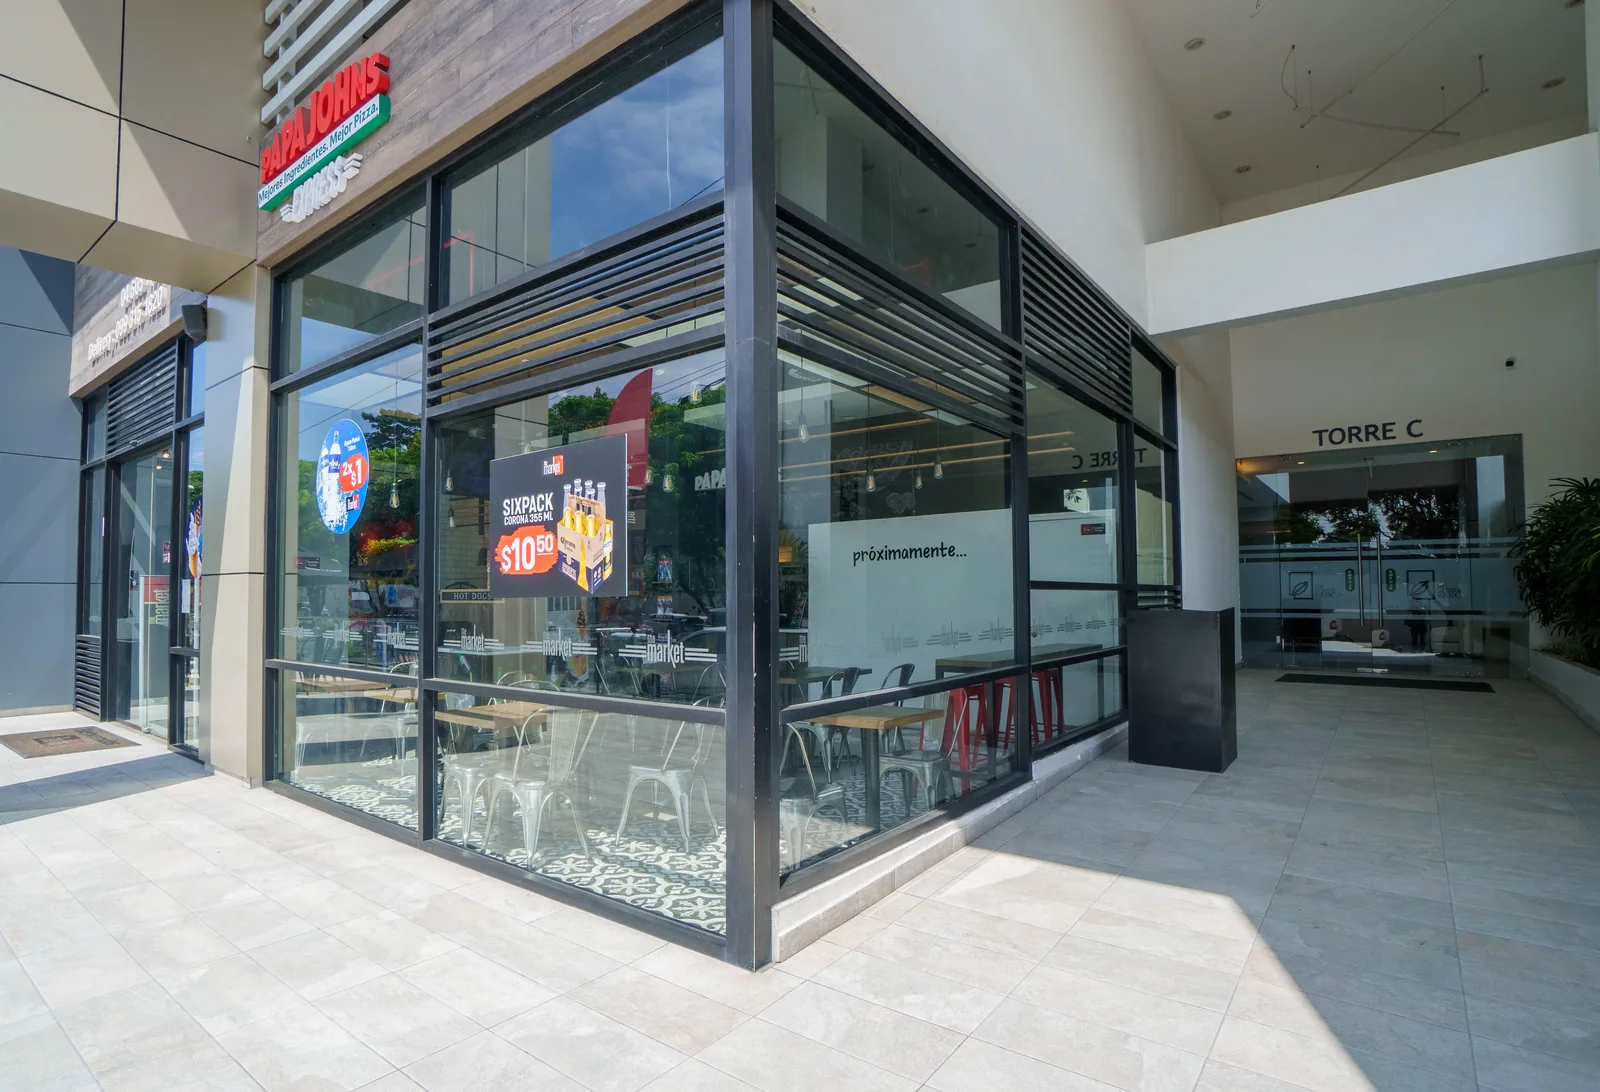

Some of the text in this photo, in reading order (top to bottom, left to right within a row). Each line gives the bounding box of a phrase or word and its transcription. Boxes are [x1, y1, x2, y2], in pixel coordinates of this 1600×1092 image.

[262, 52, 390, 184] PAPA JOHNS
[258, 104, 378, 203] Mejores Ingredientes. Mejor Pizza.
[291, 156, 348, 223] EXPRESS
[1312, 419, 1424, 447] TORRE C
[503, 492, 554, 517] SIXPACK
[504, 511, 554, 526] CORONA 355 ML
[853, 541, 968, 566] próximamente...
[453, 592, 469, 600] HOT
[461, 624, 485, 653] market
[542, 627, 573, 661] market
[647, 630, 686, 668] market
